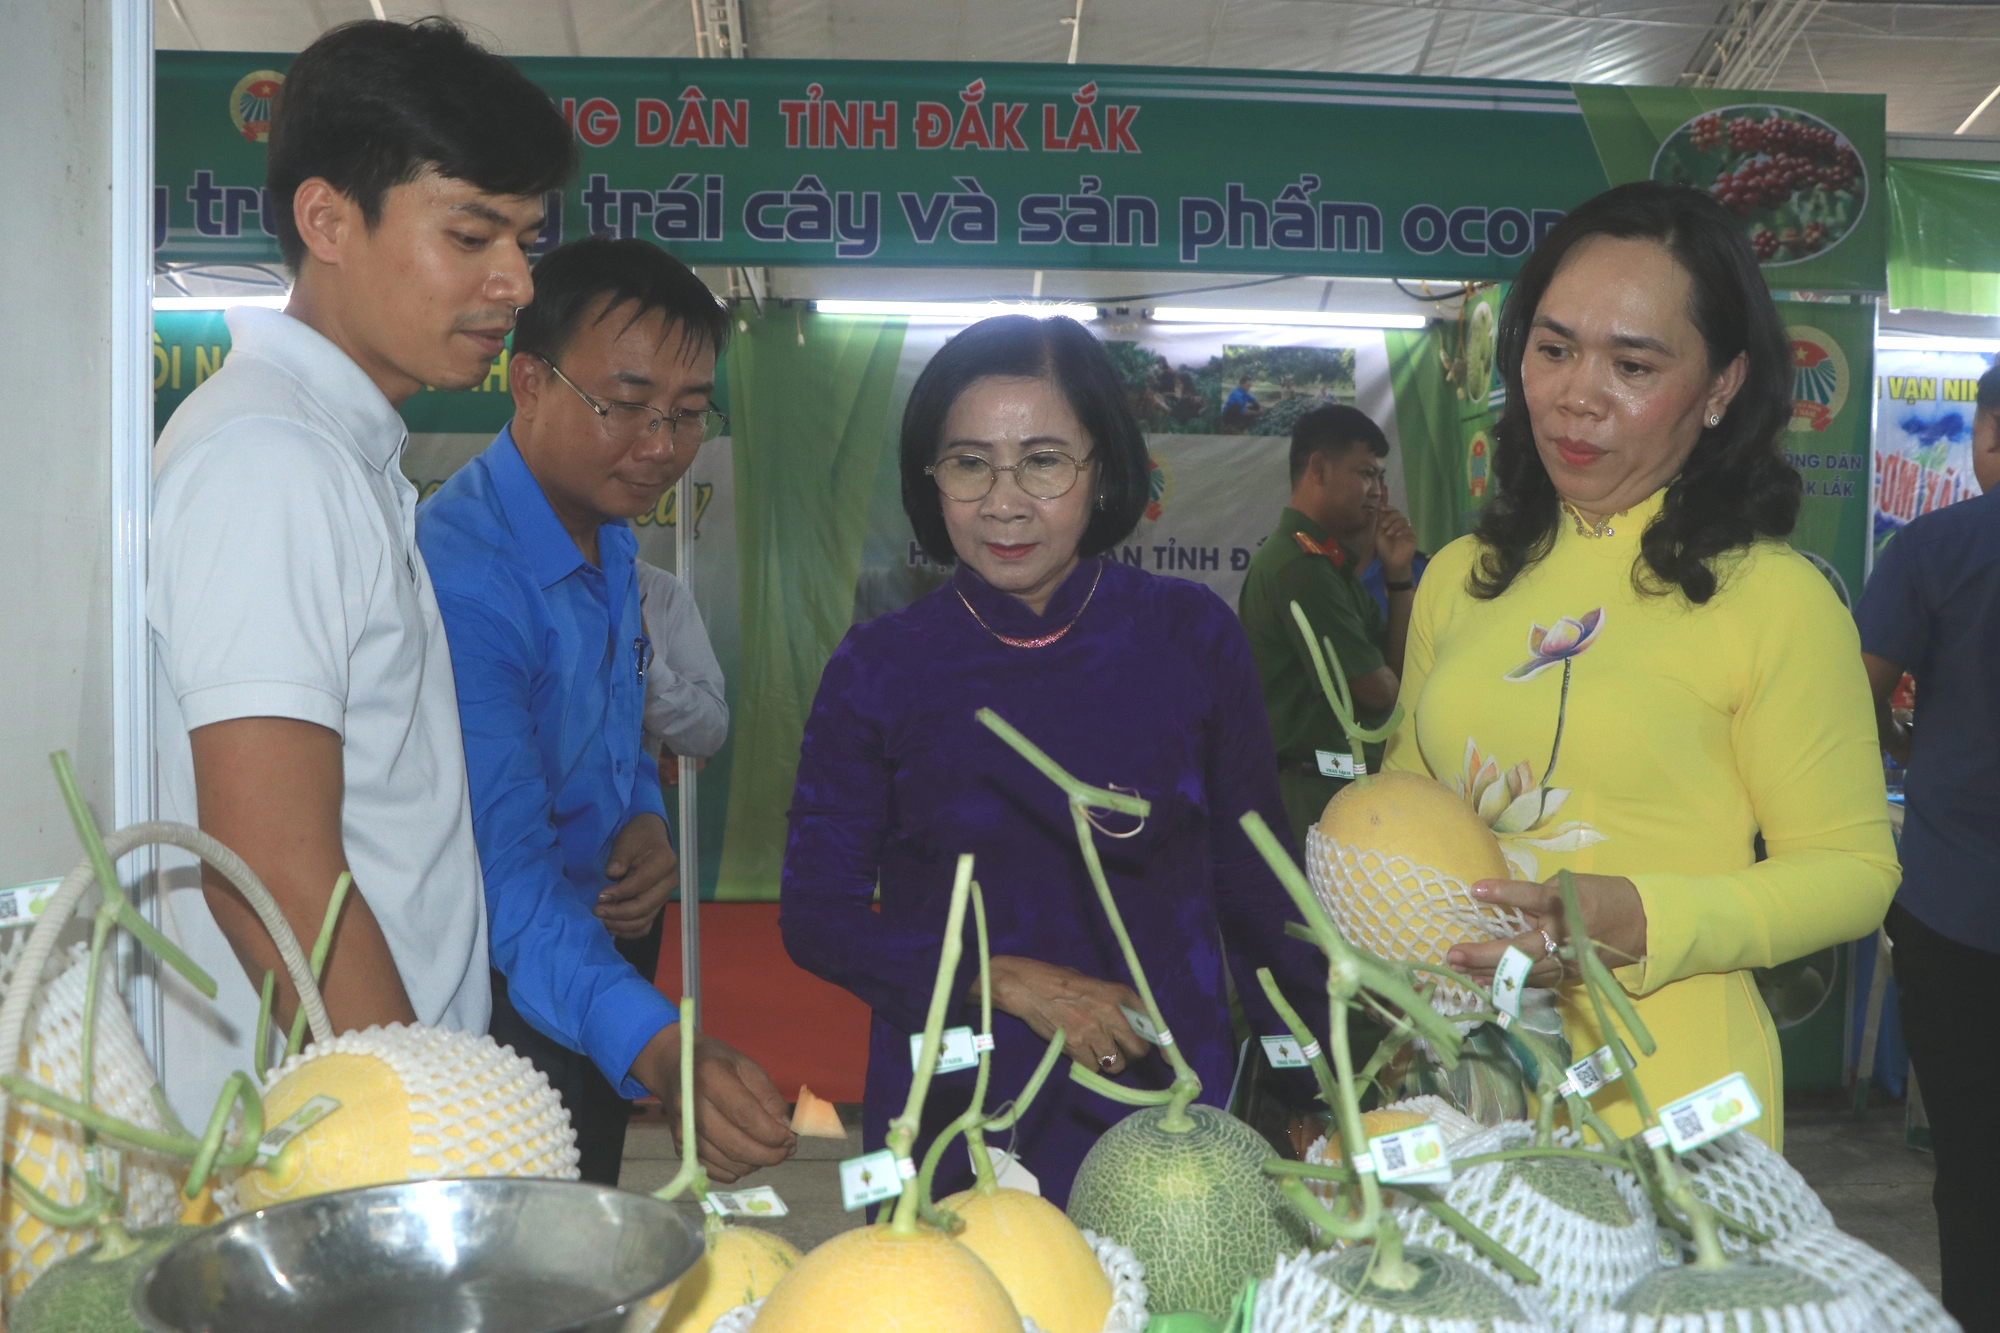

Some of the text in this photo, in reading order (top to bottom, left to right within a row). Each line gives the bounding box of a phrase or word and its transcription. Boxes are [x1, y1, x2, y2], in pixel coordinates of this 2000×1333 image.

[635, 85, 749, 147] DÂN
[780, 82, 898, 150] TỈNH
[914, 78, 1029, 153] ĐẮK
[1041, 80, 1141, 155] LẮK
[581, 173, 724, 242] trái
[743, 174, 881, 258] cây
[897, 175, 998, 245] và
[1019, 174, 1159, 246] sản
[1180, 173, 1384, 263] phẩm
[1888, 375, 1937, 405] VẠN
[1825, 451, 1863, 470] DÂN
[1822, 475, 1854, 497] LẮK
[1152, 537, 1220, 571] TỈNH
